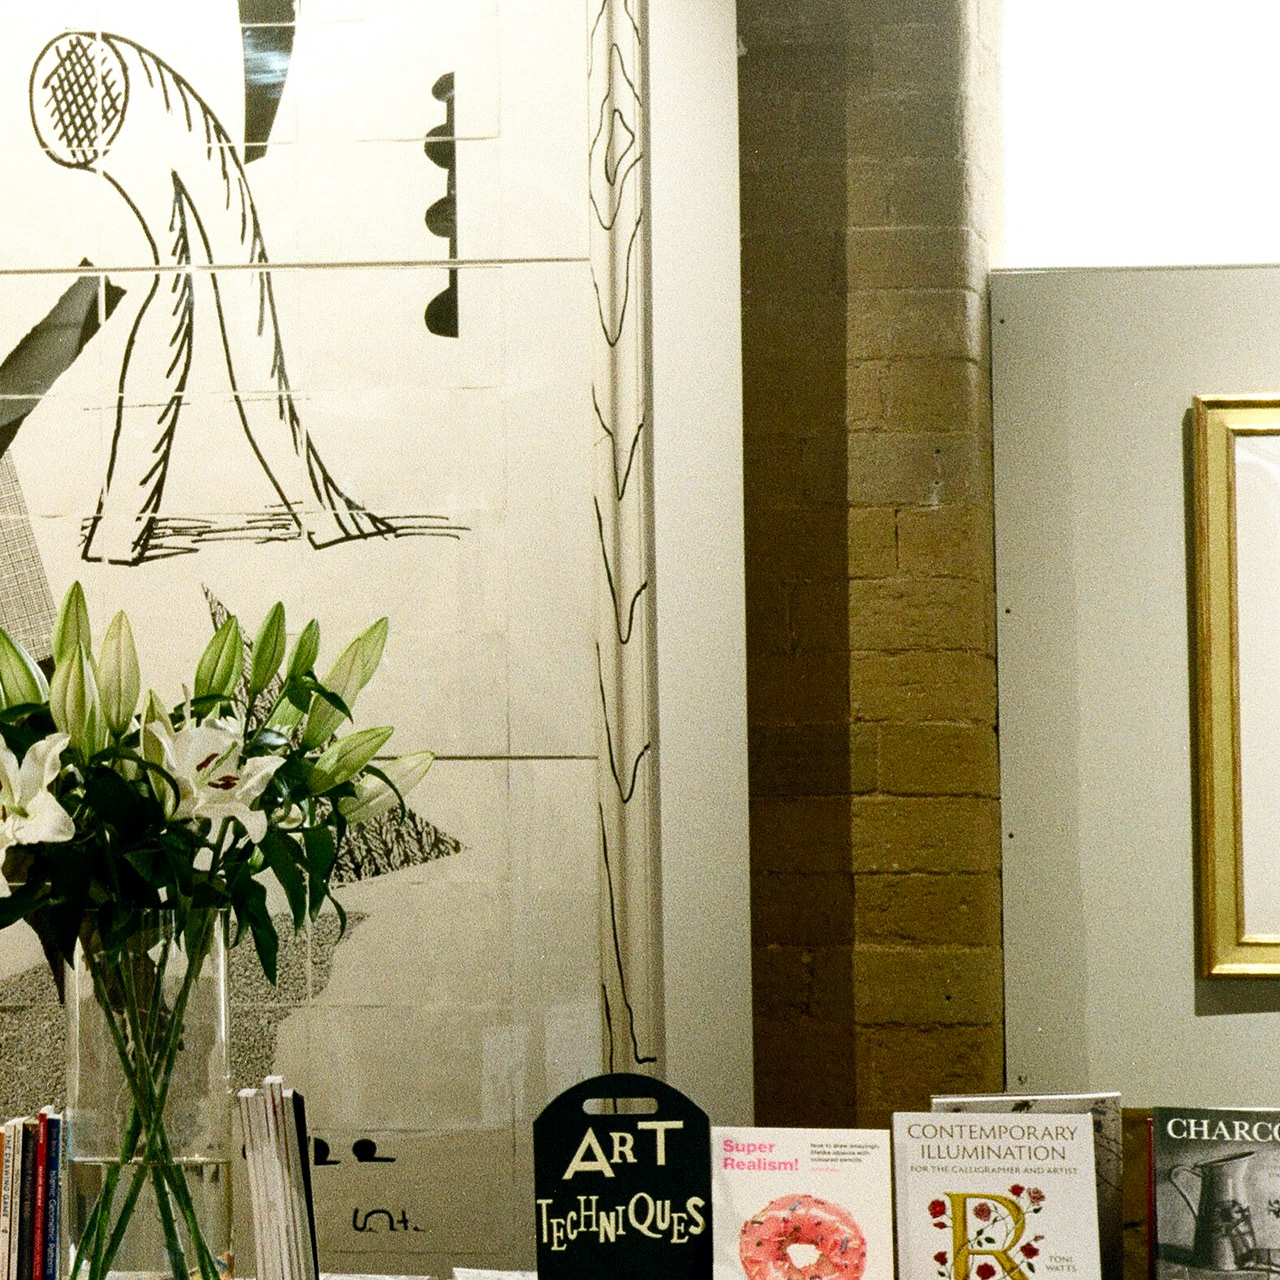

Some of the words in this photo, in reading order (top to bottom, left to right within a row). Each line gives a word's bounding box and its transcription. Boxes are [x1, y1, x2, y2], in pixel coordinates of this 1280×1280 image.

[5, 1134, 13, 1149] THE
[907, 1123, 1078, 1141] CONTEMPORARY
[562, 1120, 684, 1180] ART
[722, 1139, 776, 1155] Super
[921, 1144, 1066, 1161] ILLUMINATION
[3, 1152, 11, 1191] DRAWING
[723, 1157, 799, 1171] Realism!
[910, 1165, 929, 1173] FOR
[931, 1165, 948, 1173] THE
[1023, 1167, 1045, 1175] AND
[1046, 1167, 1078, 1176] ARTIST
[48, 1170, 58, 1196] Islamic
[2, 1194, 10, 1218] GAME
[46, 1199, 58, 1241] Geometric
[537, 1192, 706, 1251] TECHNIQUES
[45, 1243, 56, 1275] Patterns
[1046, 1265, 1077, 1273] WATTS
